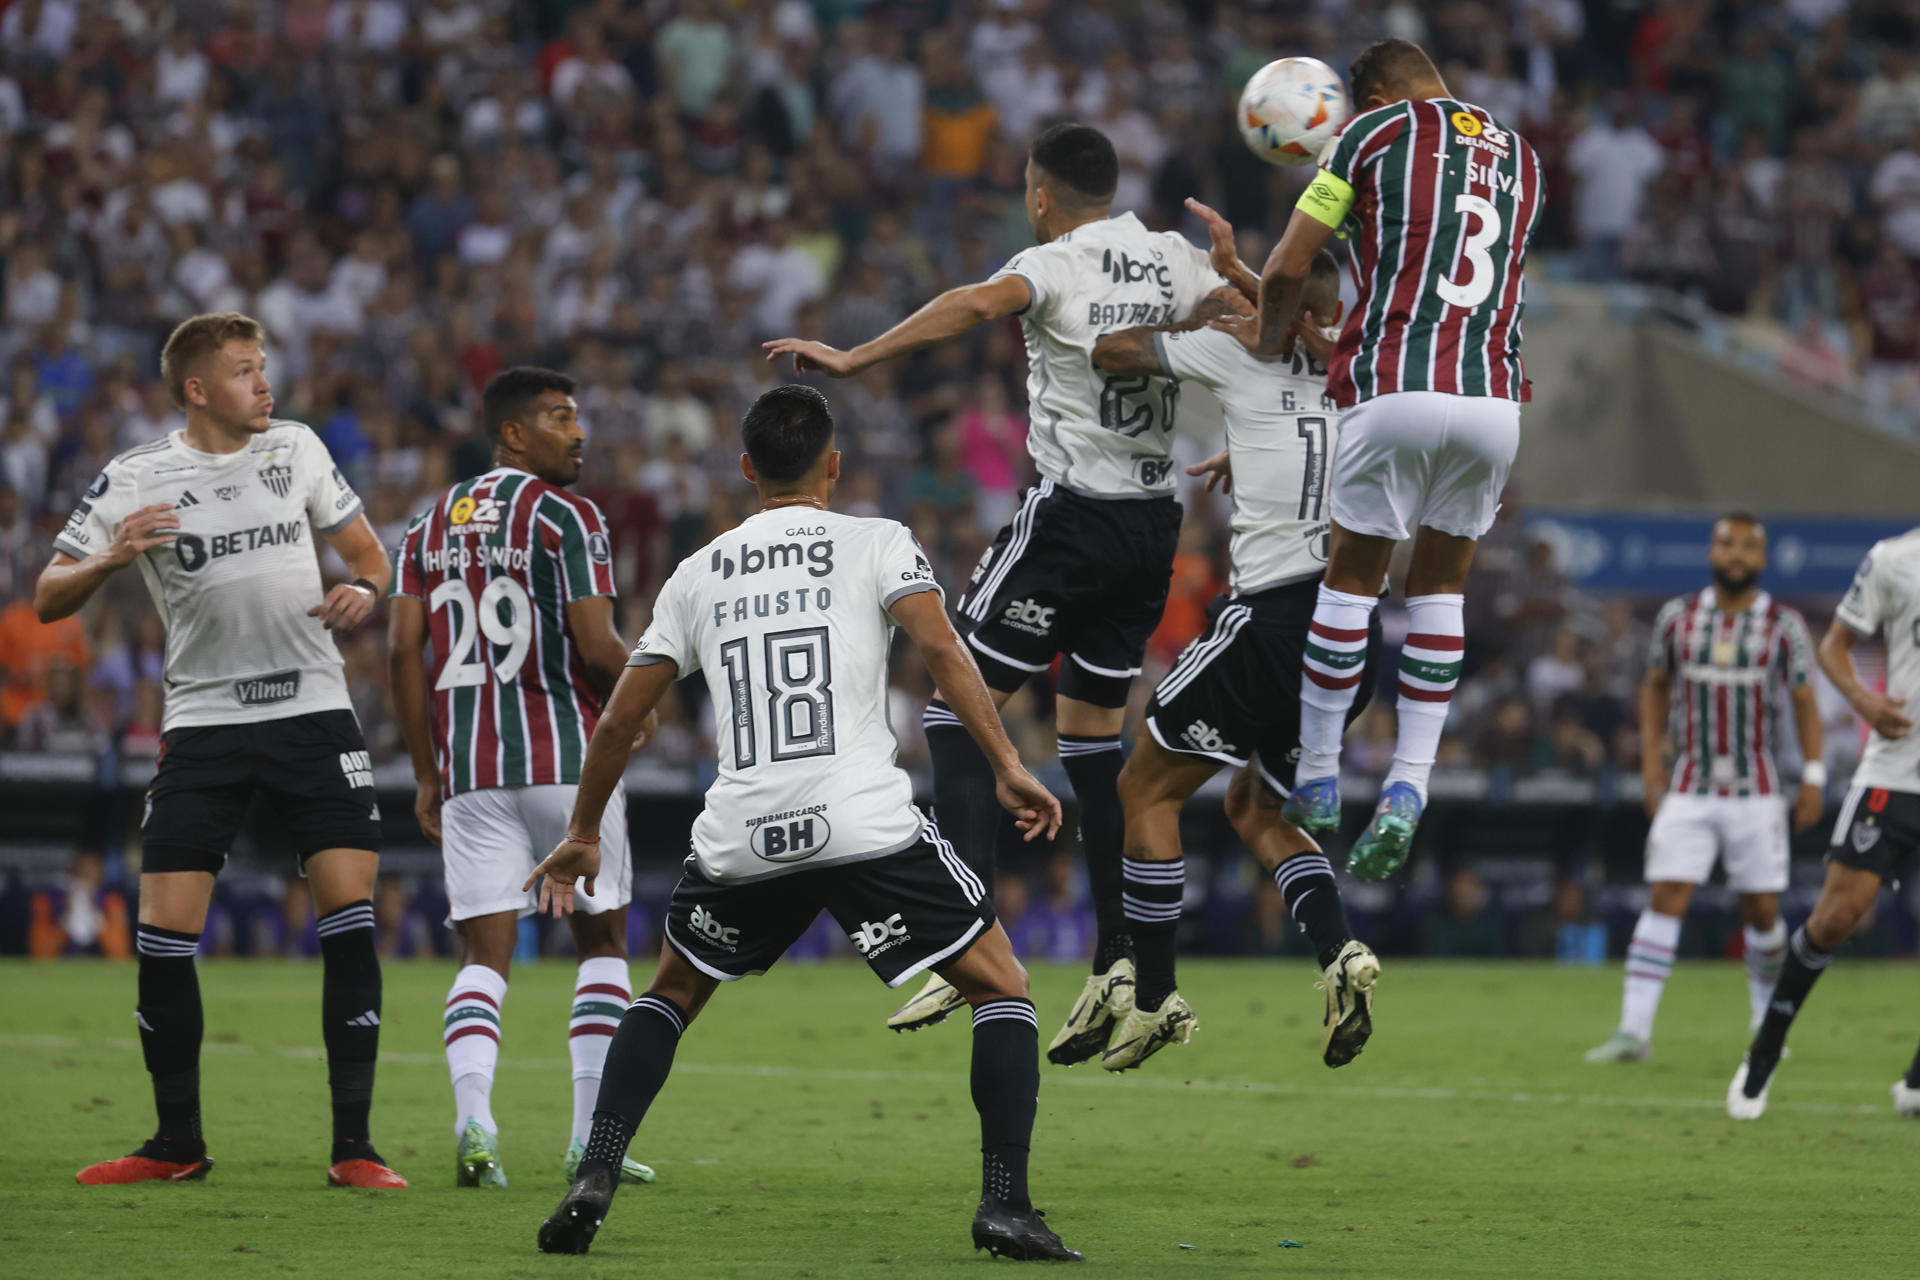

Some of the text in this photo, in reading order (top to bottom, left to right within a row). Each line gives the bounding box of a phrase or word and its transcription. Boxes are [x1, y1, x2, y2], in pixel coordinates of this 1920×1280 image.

[1455, 134, 1510, 160] DELIVERY
[1465, 161, 1524, 202] SILVA
[1434, 193, 1501, 308] 3
[210, 520, 301, 559] BETANO
[785, 526, 826, 537] GALO
[475, 544, 532, 571] SANTOS
[740, 539, 834, 577] bmg
[713, 586, 831, 627] FAUSTO
[1004, 598, 1056, 628] abc
[430, 577, 532, 691] 29
[237, 680, 295, 702] Vilma
[720, 625, 836, 771] 18
[817, 702, 829, 748] mundiale
[744, 803, 828, 828] SUPERMERCADOS
[763, 818, 814, 857] BH
[690, 904, 740, 945] abc
[848, 912, 908, 954] abc
[868, 934, 912, 960] construção
